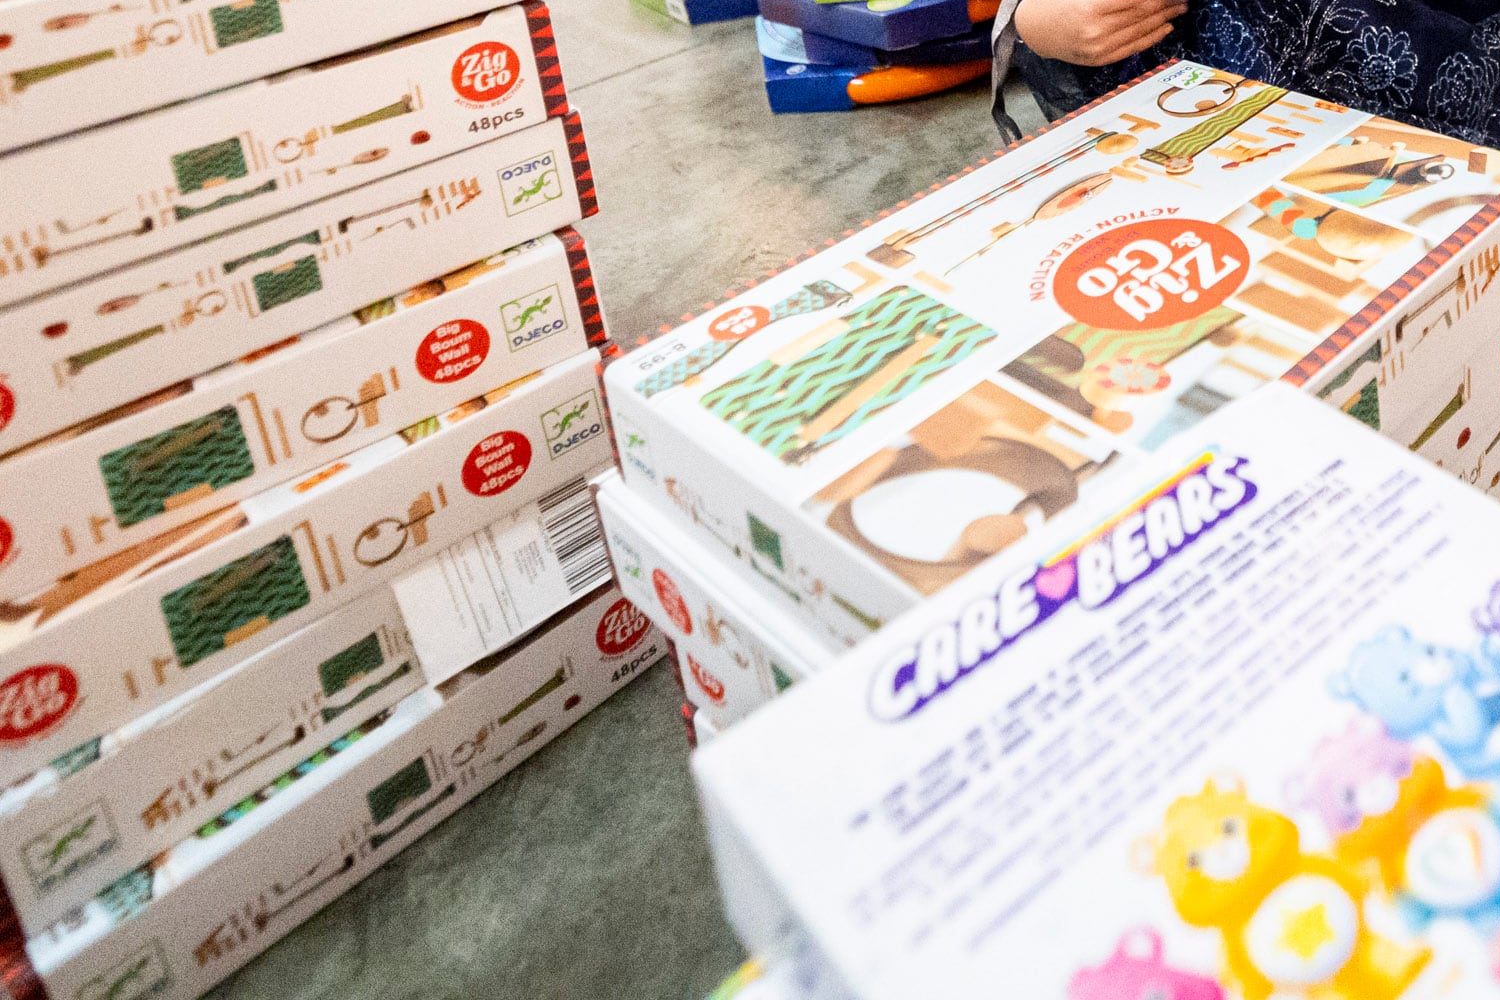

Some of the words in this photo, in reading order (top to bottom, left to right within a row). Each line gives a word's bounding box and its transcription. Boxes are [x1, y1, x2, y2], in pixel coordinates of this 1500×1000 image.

[461, 48, 508, 77] Zig
[474, 69, 512, 93] Go
[468, 107, 525, 134] 48pcs
[501, 155, 553, 181] DJECO
[1094, 206, 1181, 231] ACTION
[1170, 230, 1203, 249] &
[1028, 232, 1086, 302] REACTION
[1076, 238, 1174, 298] Go
[1113, 241, 1242, 323] Zig
[430, 331, 473, 354] Boum
[435, 322, 461, 339] Big
[512, 319, 565, 347] DJECO
[438, 344, 471, 364] Wall
[433, 355, 482, 381] 48pcs
[480, 435, 505, 452] Big
[552, 423, 601, 455] DJECO
[474, 442, 516, 469] Boum
[482, 455, 514, 477] Wall
[479, 464, 525, 494] 48pcs
[870, 566, 1044, 724] CARE
[1075, 455, 1258, 609] BEARS
[610, 645, 658, 684] 48pcs
